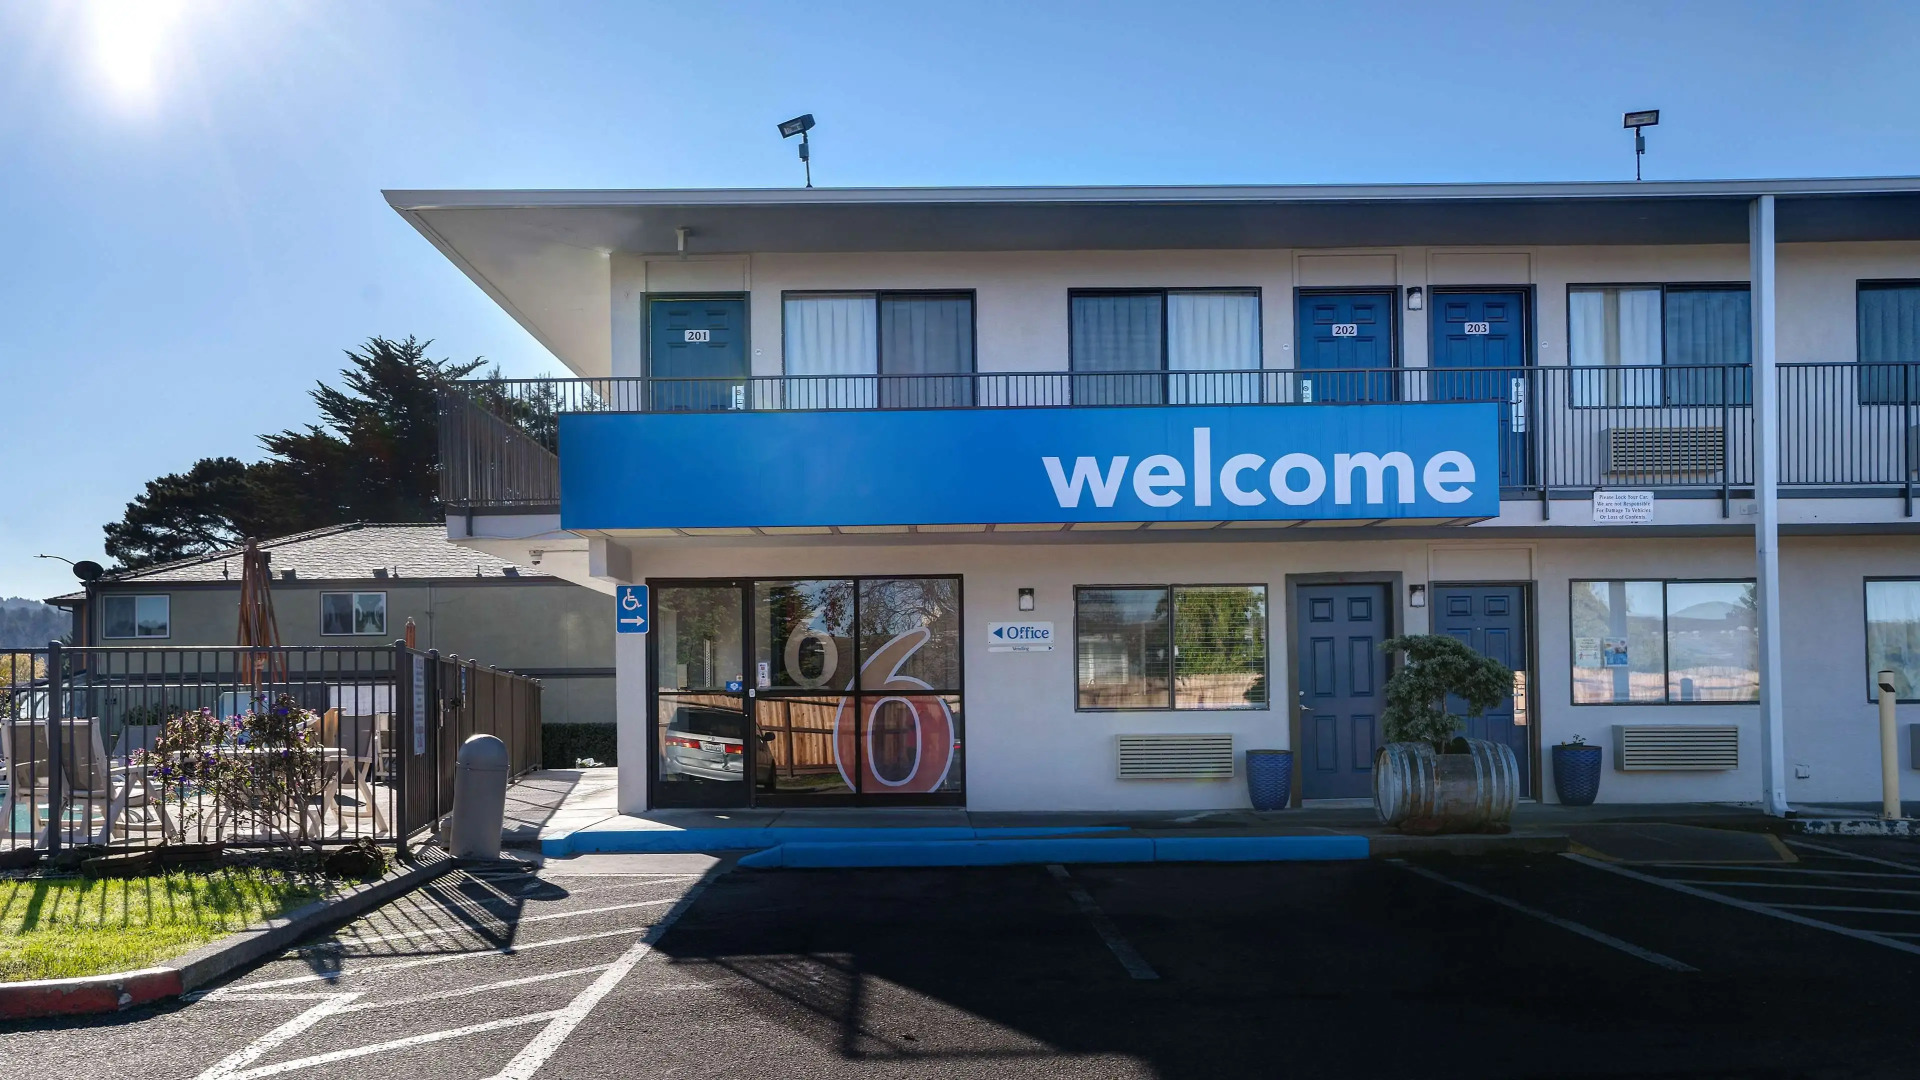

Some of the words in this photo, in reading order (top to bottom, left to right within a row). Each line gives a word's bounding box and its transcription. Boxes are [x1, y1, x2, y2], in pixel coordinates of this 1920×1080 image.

[1335, 326, 1355, 335] 202
[1467, 323, 1487, 333] 203
[688, 331, 707, 341] 201
[1041, 427, 1476, 508] welcome
[1006, 626, 1049, 639] Office
[833, 627, 954, 793] 6
